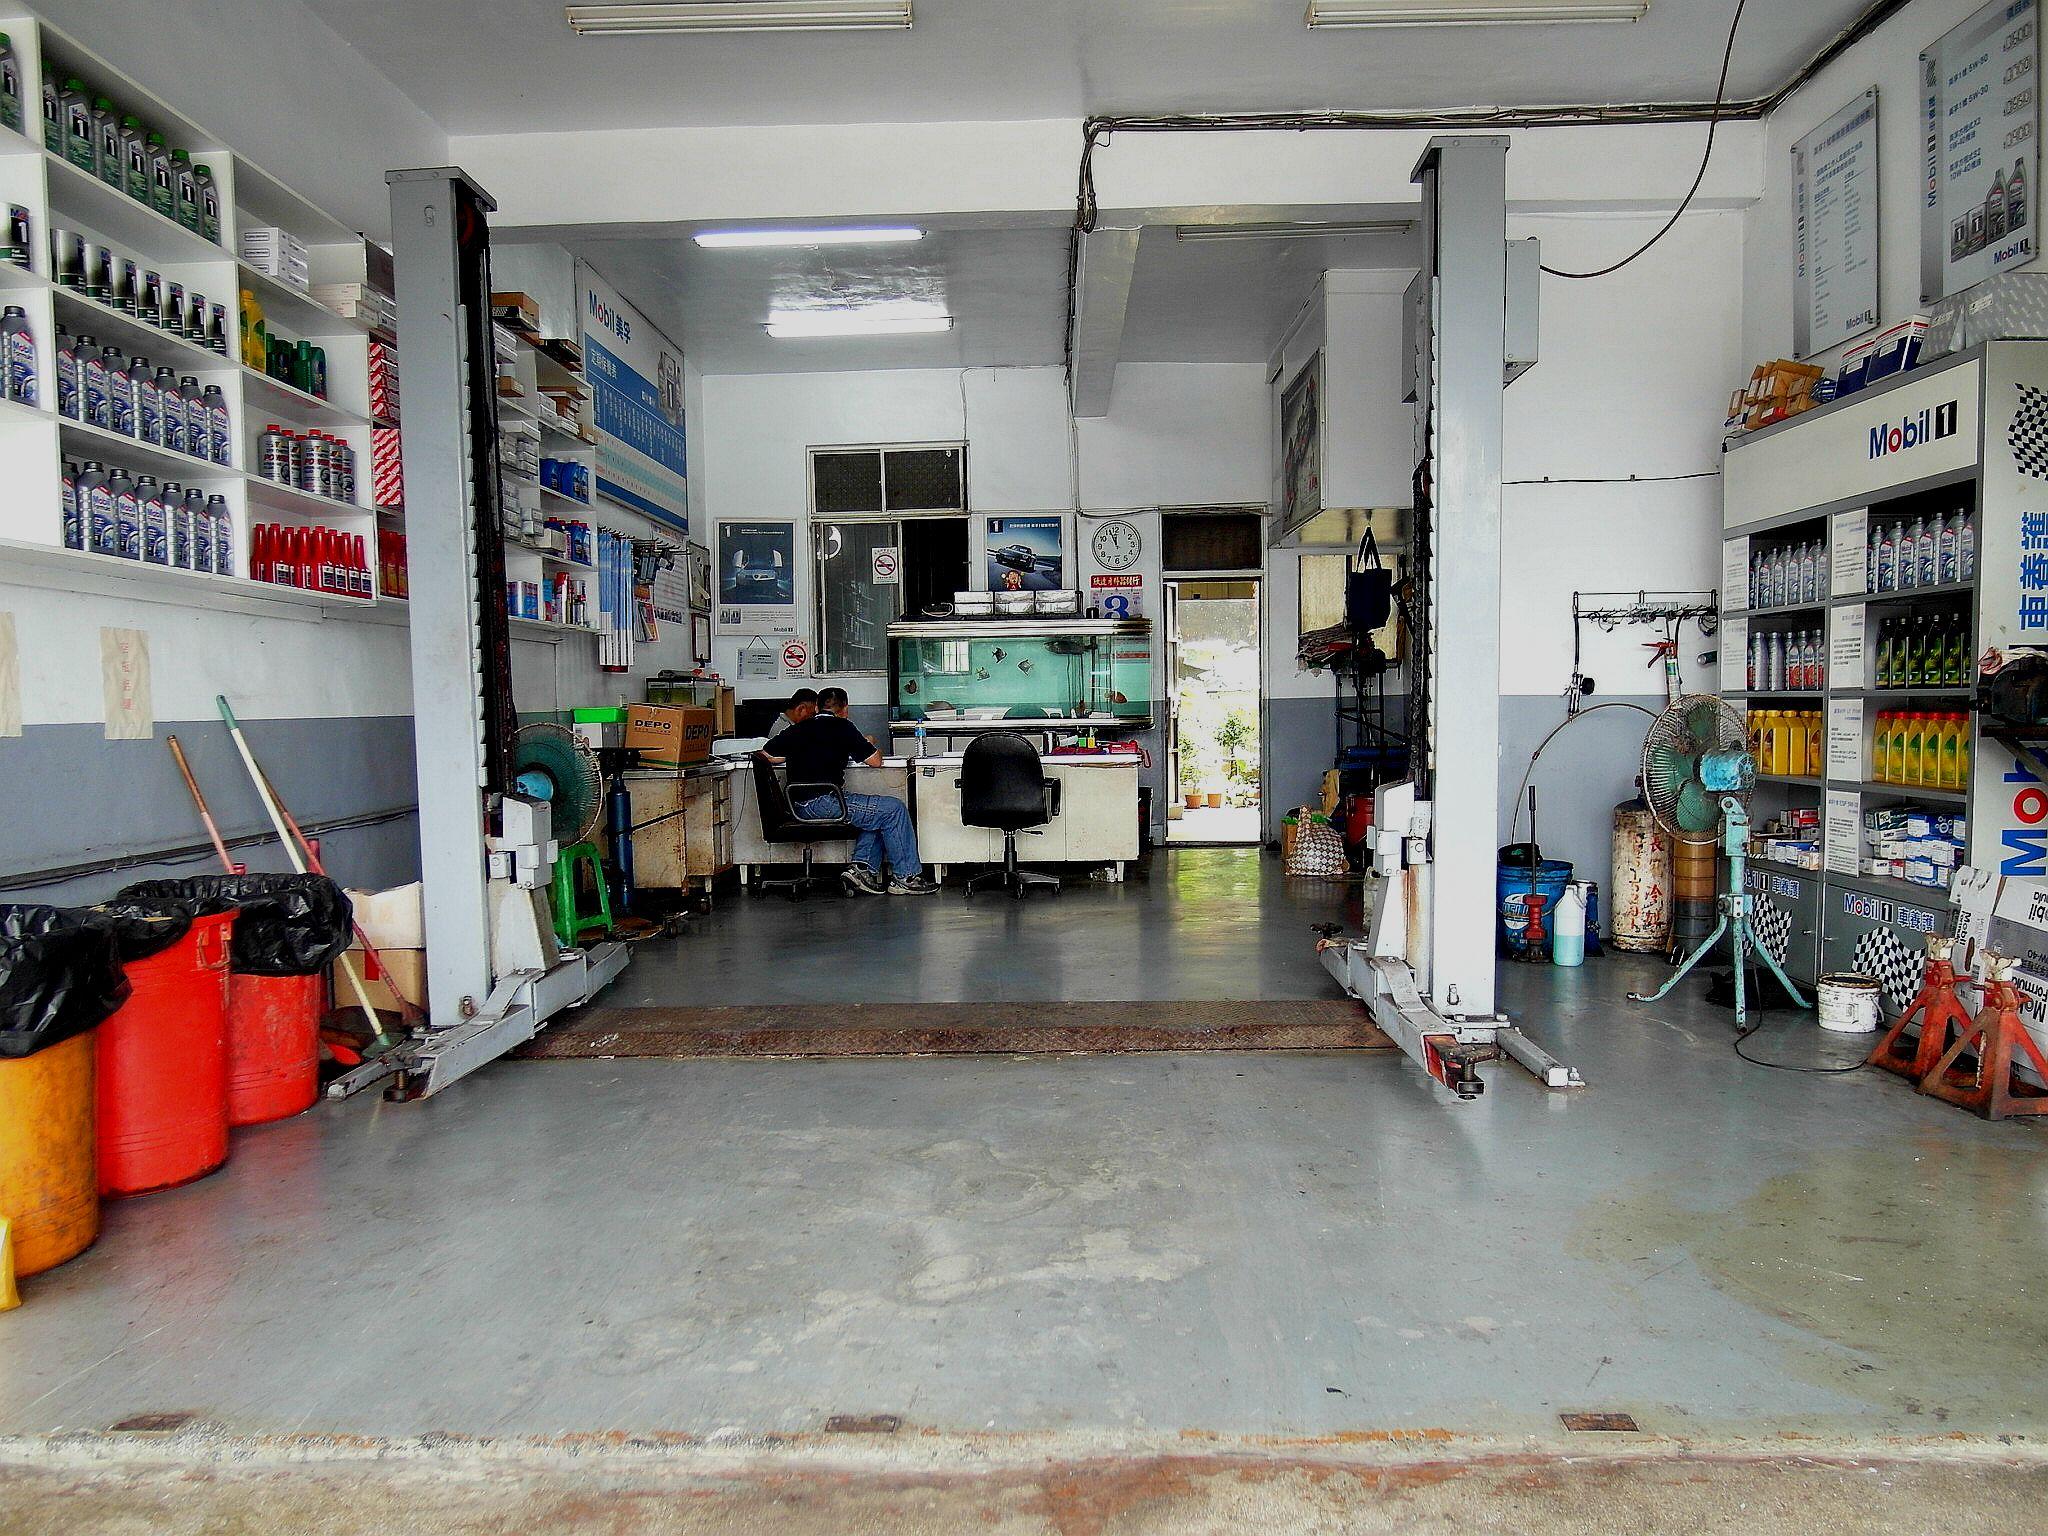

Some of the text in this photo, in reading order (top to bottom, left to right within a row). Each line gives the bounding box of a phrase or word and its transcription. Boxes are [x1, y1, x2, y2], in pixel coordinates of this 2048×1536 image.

[1927, 155, 1937, 208] Mobil
[1994, 239, 2018, 265] Mobil
[589, 290, 631, 345] Mobil 美孚
[1846, 314, 1863, 330] Mobil
[1869, 408, 1930, 459] Mobil
[725, 526, 730, 538] 1
[635, 720, 672, 730] DEPO
[685, 725, 710, 740] DEPO
[1772, 876, 1799, 899] 車養護
[1844, 893, 1879, 920] Mobil
[1897, 907, 1935, 933] 車養護
[1960, 911, 1971, 946] Mobil
[2012, 977, 2048, 1002] Formula
